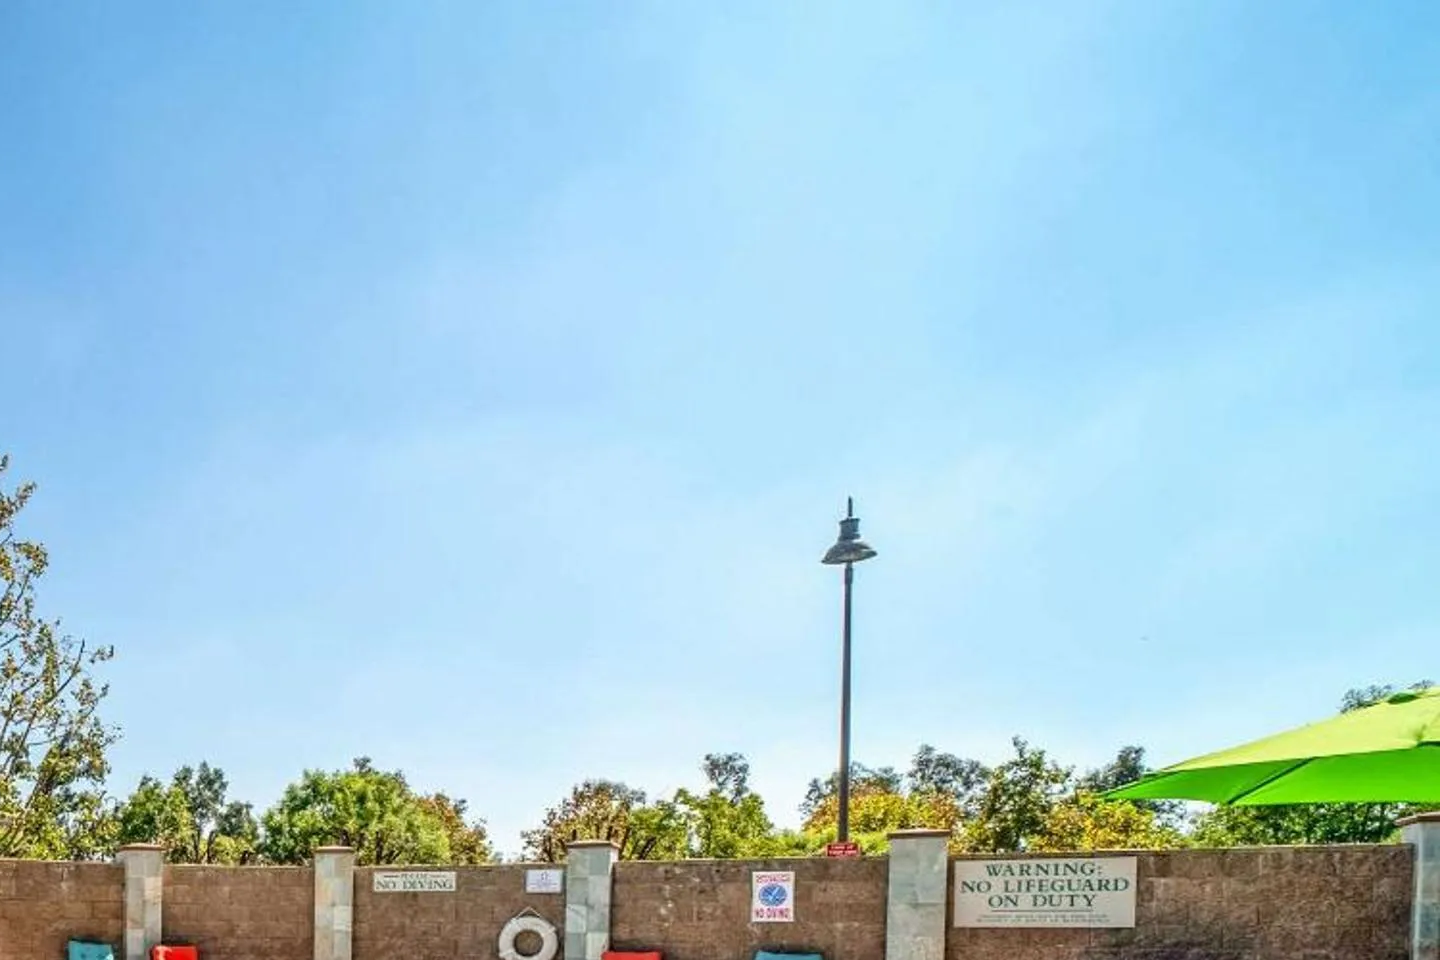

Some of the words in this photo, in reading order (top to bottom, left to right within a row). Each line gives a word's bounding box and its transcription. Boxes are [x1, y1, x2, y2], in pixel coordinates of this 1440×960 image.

[986, 861, 1103, 877] WARNING:
[375, 880, 396, 890] NO
[402, 879, 453, 890] DIVING
[960, 880, 992, 893] NO
[1004, 877, 1130, 893] LIFEGUARD
[988, 894, 1019, 908] ON
[1031, 894, 1097, 908] DUTY
